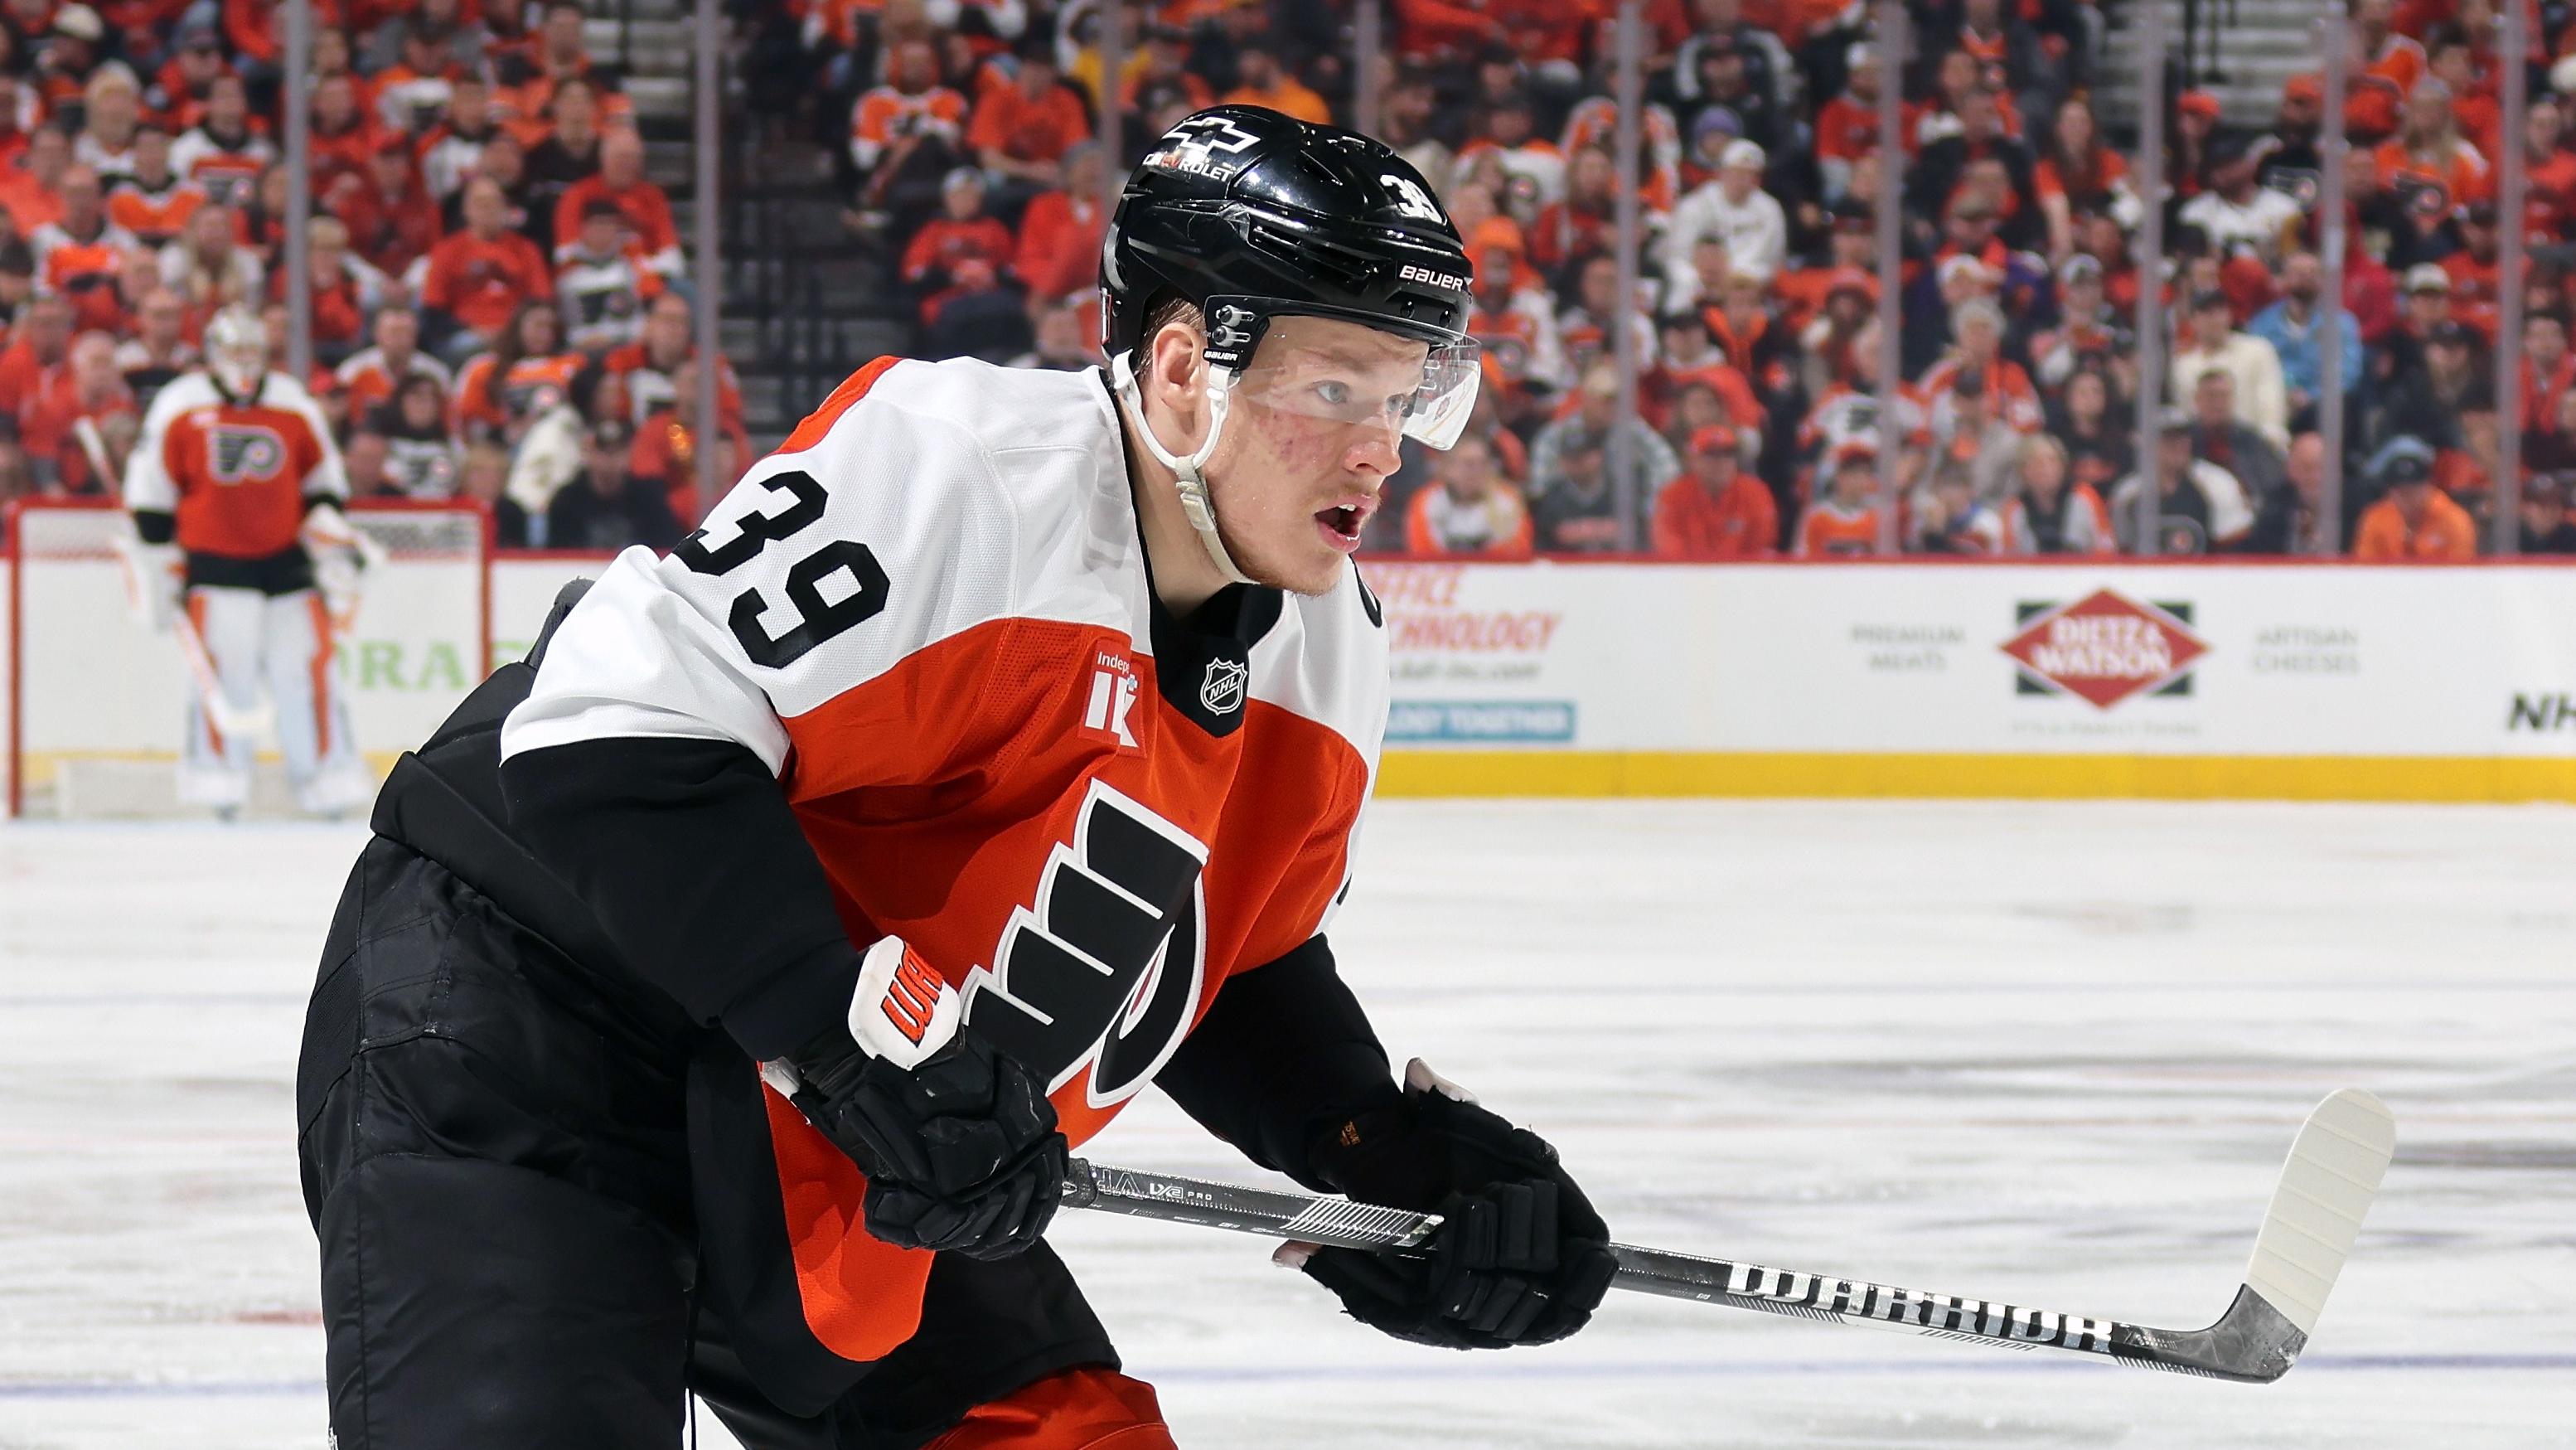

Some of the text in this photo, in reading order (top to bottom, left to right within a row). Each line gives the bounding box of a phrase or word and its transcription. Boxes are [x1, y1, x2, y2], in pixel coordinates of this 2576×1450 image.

[1142, 152, 1234, 182] CHEVROLET
[1380, 174, 1443, 224] 39
[672, 470, 891, 670] 39
[2050, 616, 2144, 647] DIETZ
[2030, 643, 2173, 678] WATSON
[1209, 676, 1237, 700] NHL
[1187, 1191, 1213, 1200] PRO
[1726, 1260, 2113, 1353] WARRIOR
[1919, 1328, 2039, 1352] WARRIOR
